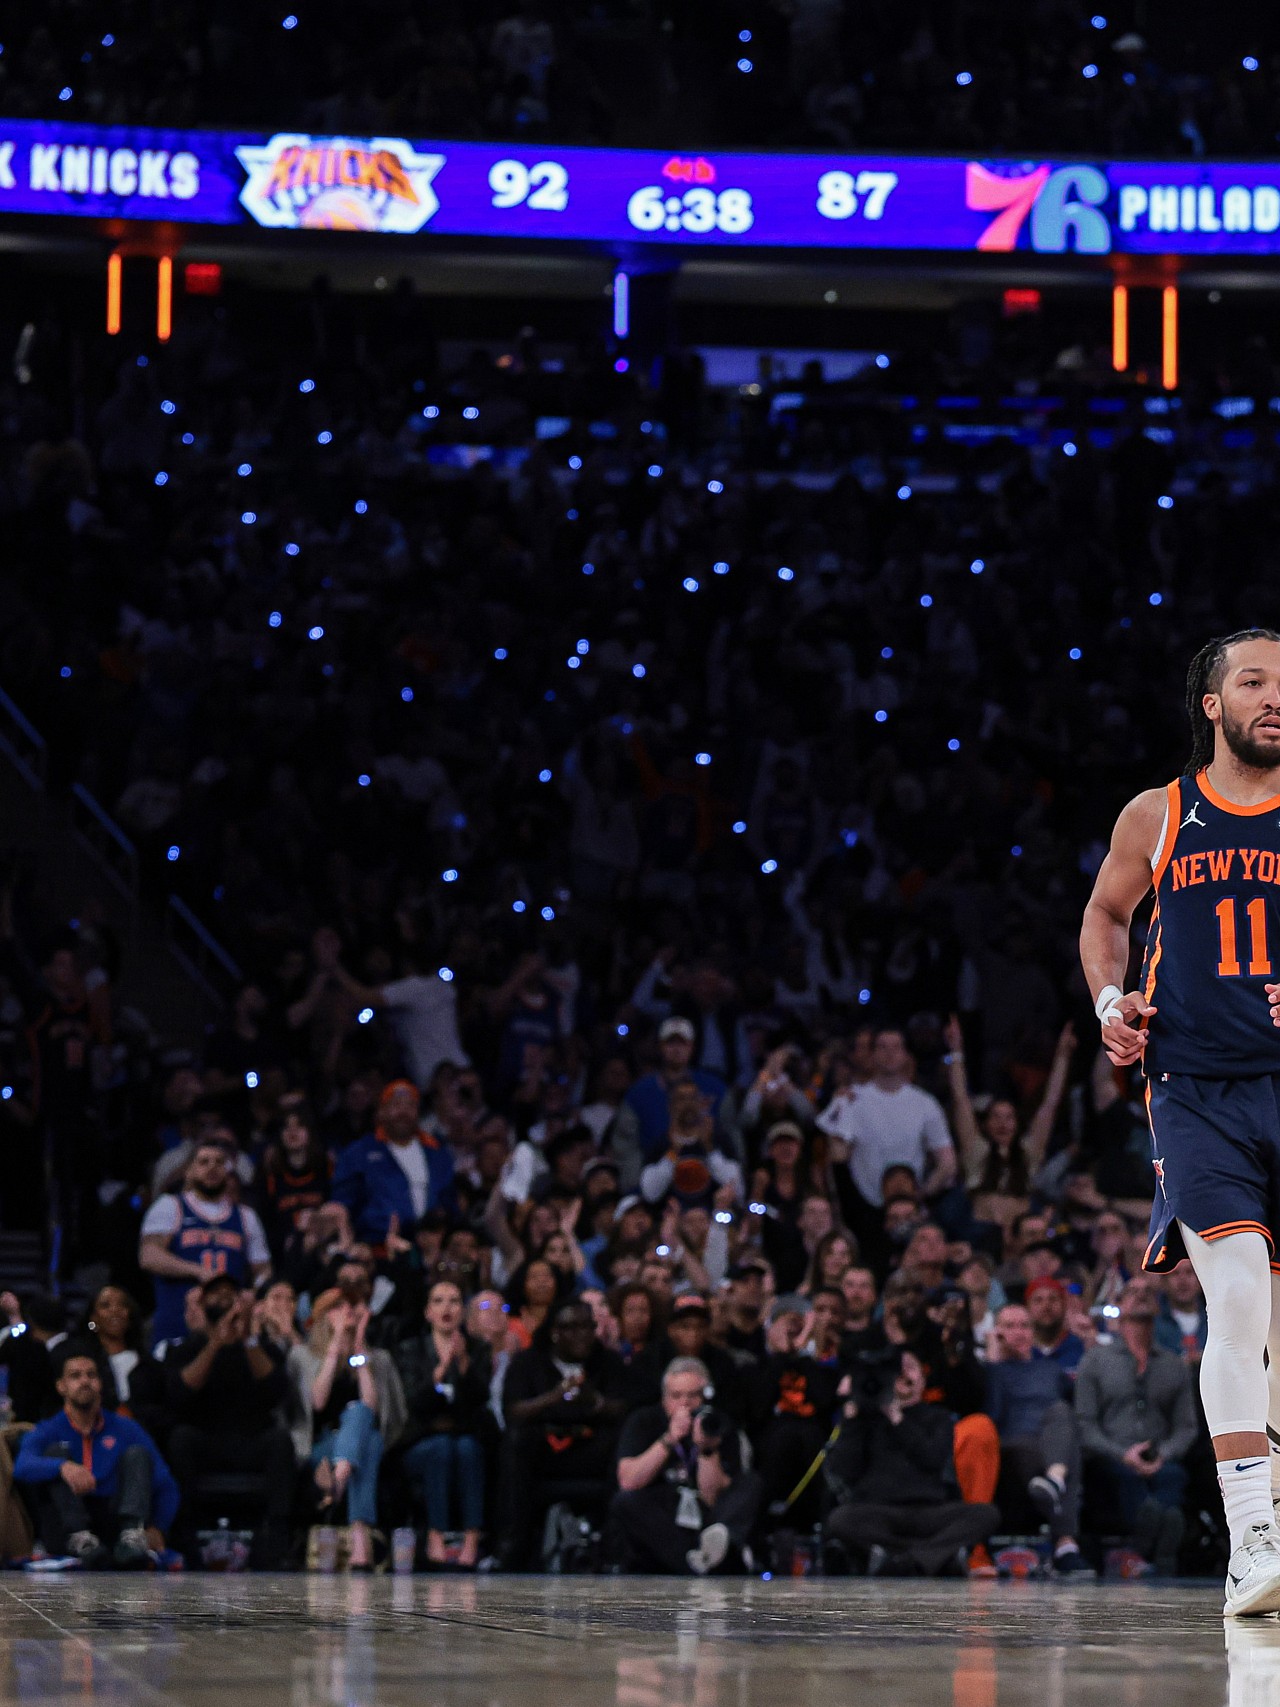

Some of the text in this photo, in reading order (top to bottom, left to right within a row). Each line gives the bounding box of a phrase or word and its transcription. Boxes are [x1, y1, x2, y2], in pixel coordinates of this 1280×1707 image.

[30, 142, 200, 199] KNICKS
[488, 160, 569, 212] 92
[816, 170, 898, 220] 87
[627, 186, 754, 235] 6:38
[966, 162, 1111, 254] 76
[1171, 849, 1235, 892] NEW
[1214, 896, 1273, 978] 11
